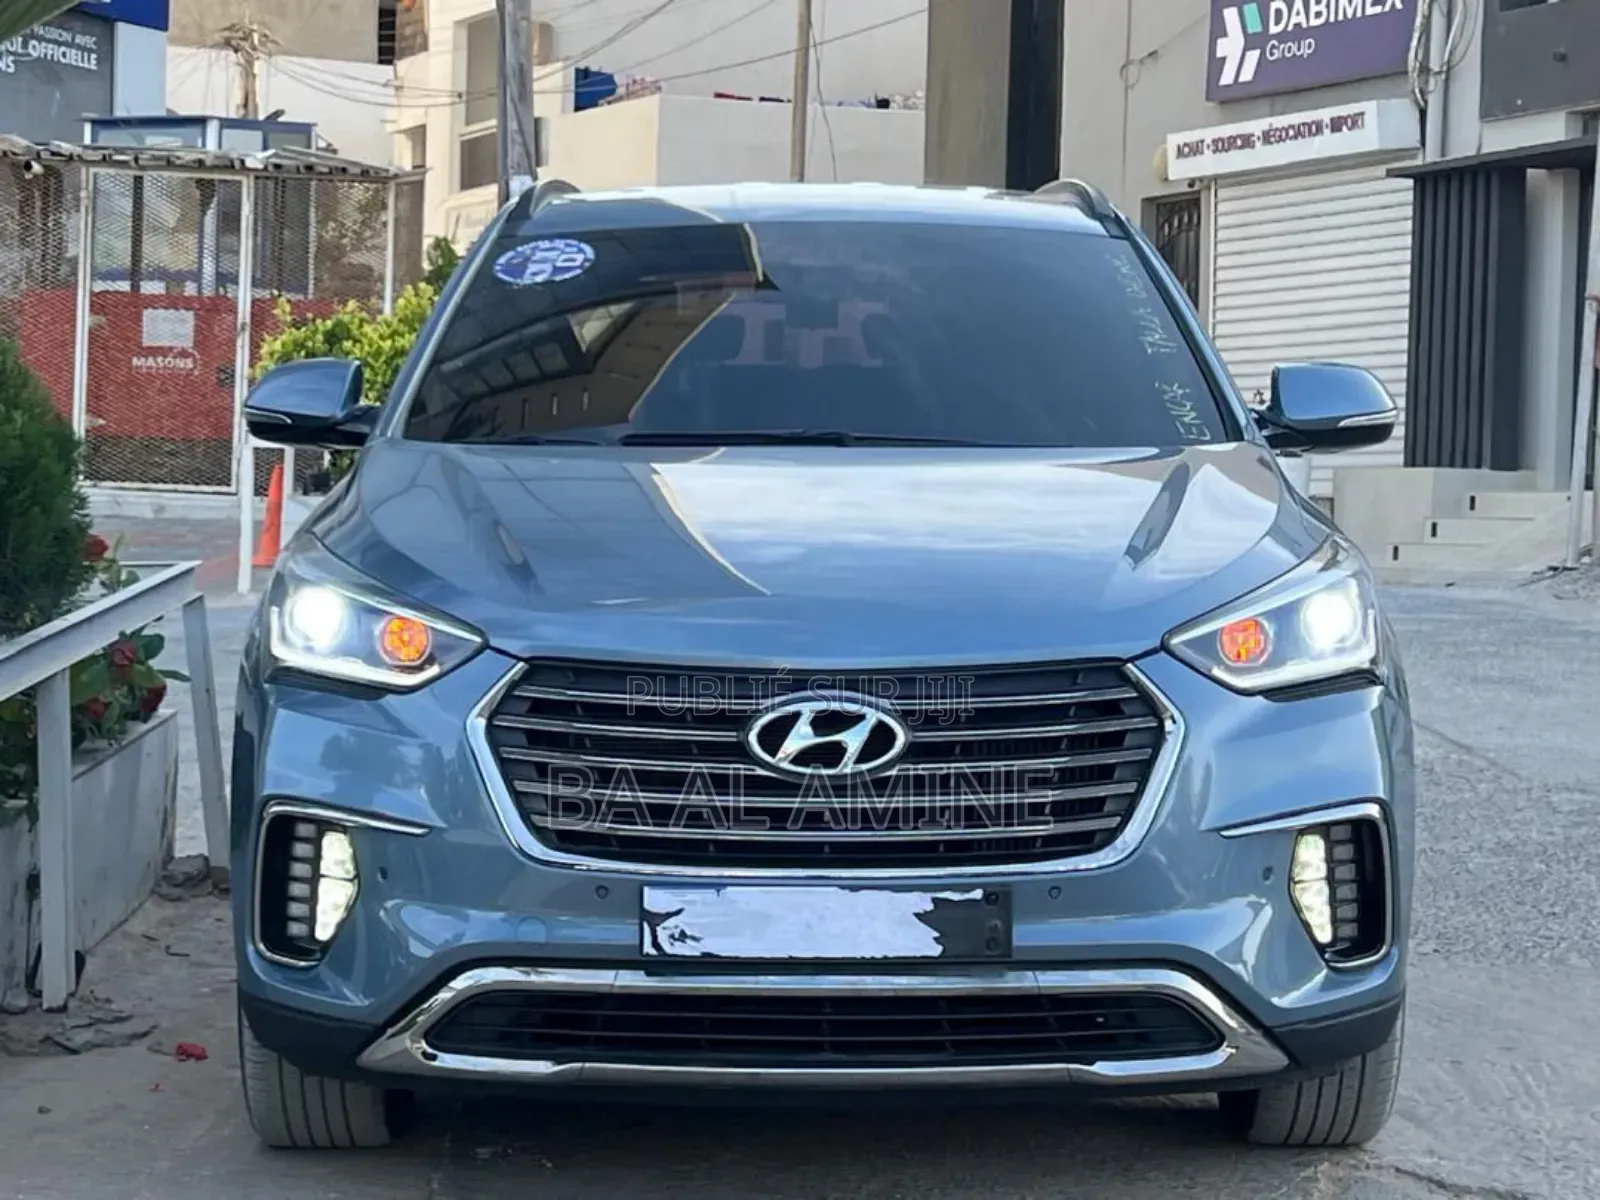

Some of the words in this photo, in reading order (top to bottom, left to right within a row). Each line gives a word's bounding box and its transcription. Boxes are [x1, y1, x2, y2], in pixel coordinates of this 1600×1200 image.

[28, 39, 98, 70] OFFICIELLE
[1265, 37, 1316, 61] Group
[1175, 138, 1205, 160] ACHAT
